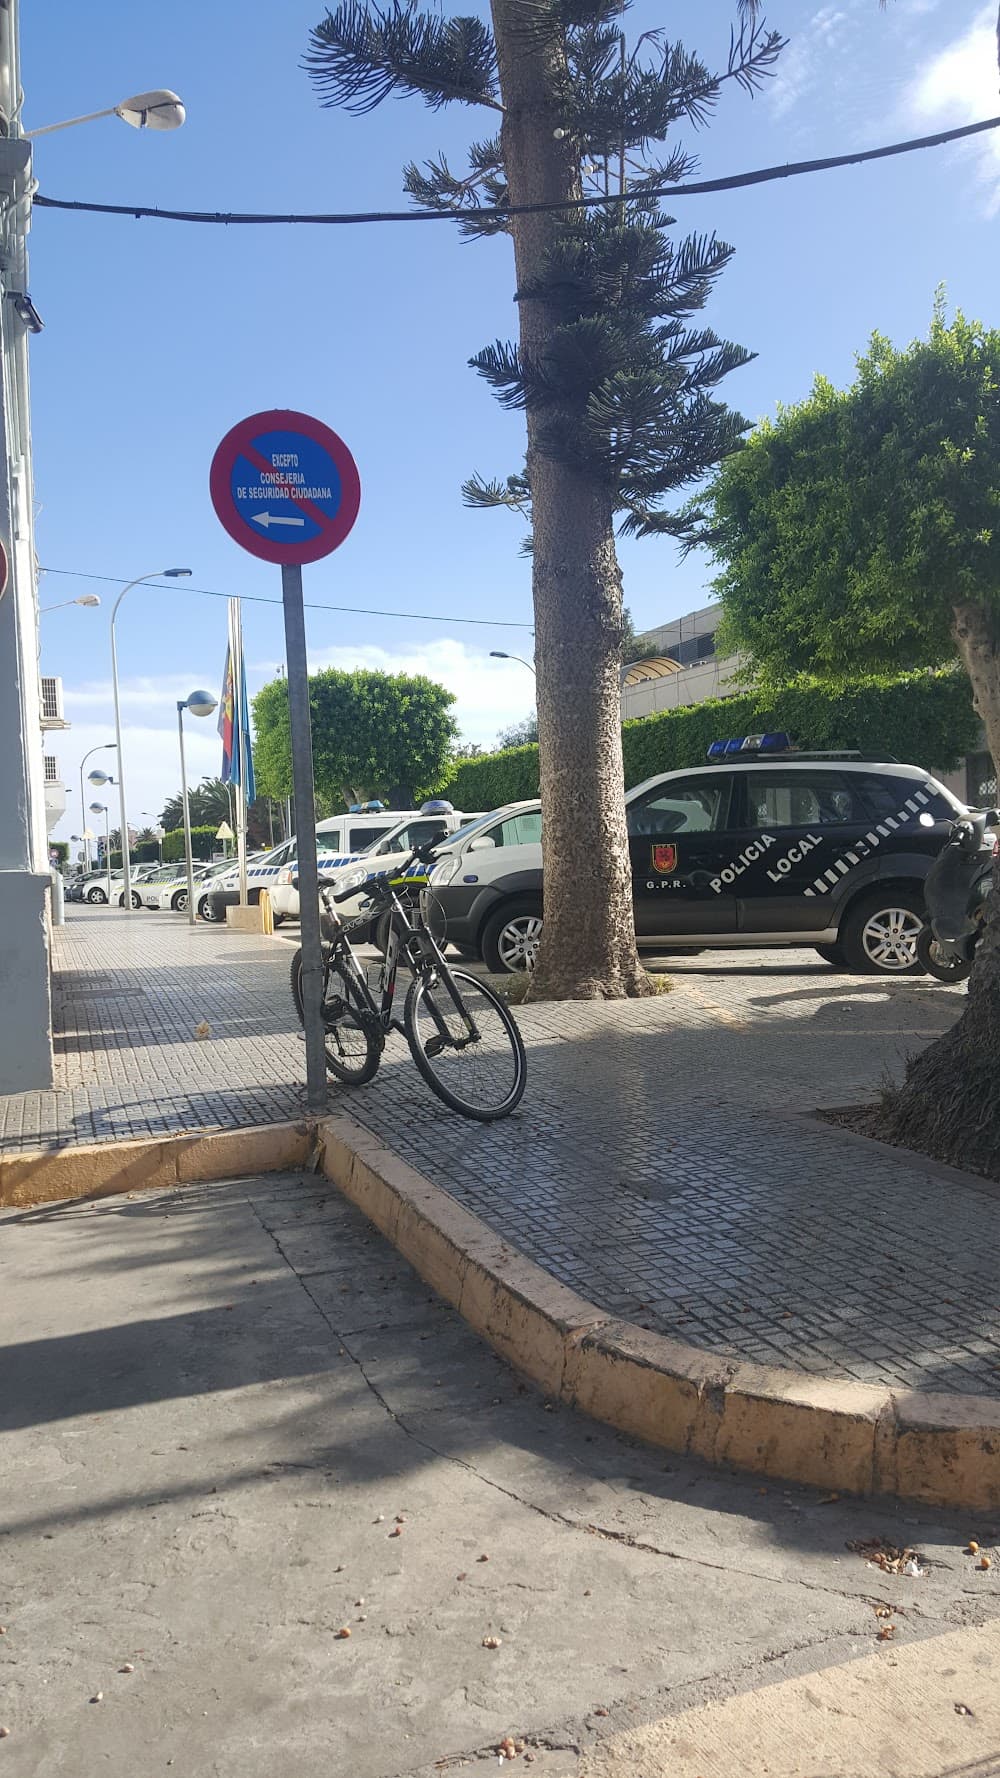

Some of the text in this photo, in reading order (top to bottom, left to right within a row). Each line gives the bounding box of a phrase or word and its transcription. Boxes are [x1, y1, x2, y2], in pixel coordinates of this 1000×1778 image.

[272, 453, 299, 467] EXCEPTO
[260, 472, 305, 484] CONSEJERIA
[237, 487, 332, 499] DE SEGURIDAD CIUDADANA
[709, 833, 777, 894] POLICIA
[766, 833, 823, 883] LOCAL
